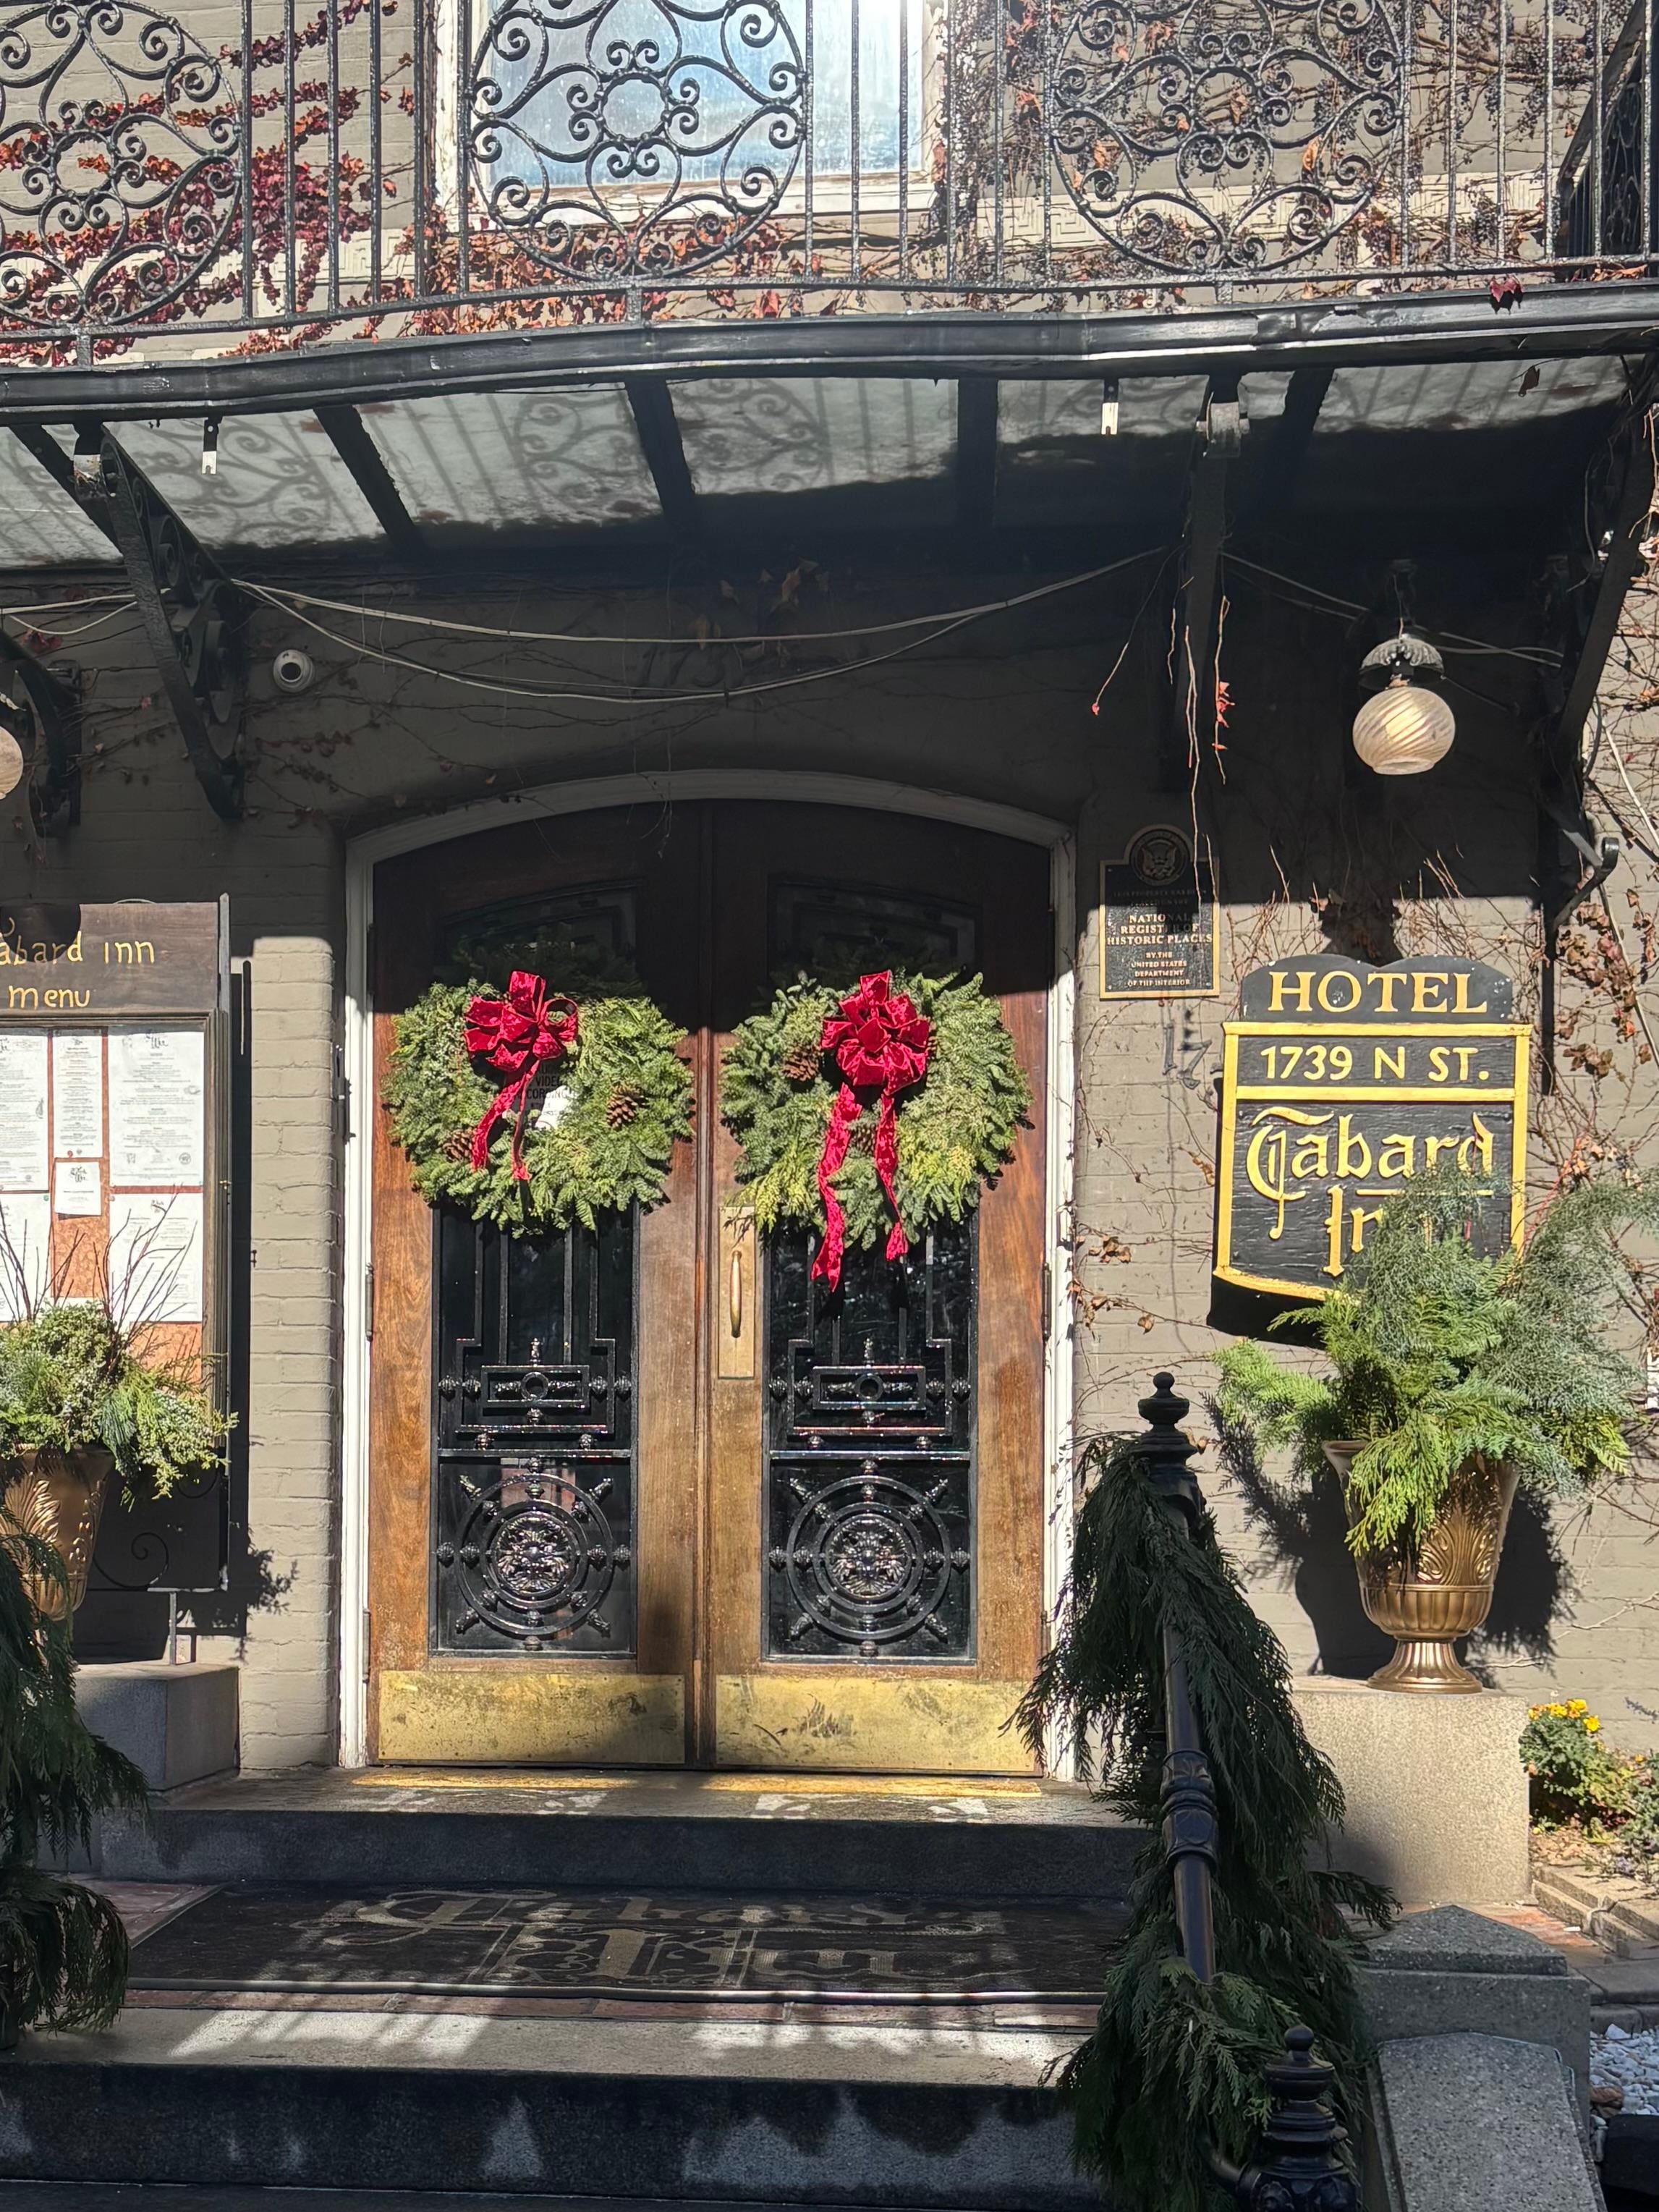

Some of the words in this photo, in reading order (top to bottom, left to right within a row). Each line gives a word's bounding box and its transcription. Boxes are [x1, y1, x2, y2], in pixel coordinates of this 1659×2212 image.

[1129, 912, 1191, 923] NATIONAL
[1183, 923, 1200, 932] OF
[0, 918, 82, 965] abard
[1107, 935, 1164, 945] HISTORIC
[1167, 933, 1213, 944] PLACES
[9, 985, 90, 1009] menu
[1268, 970, 1488, 1013] HOTEL
[1260, 1044, 1353, 1080] 1739
[1375, 1046, 1405, 1080] N
[1428, 1046, 1489, 1082] ST.
[1246, 1106, 1494, 1240] Tabard
